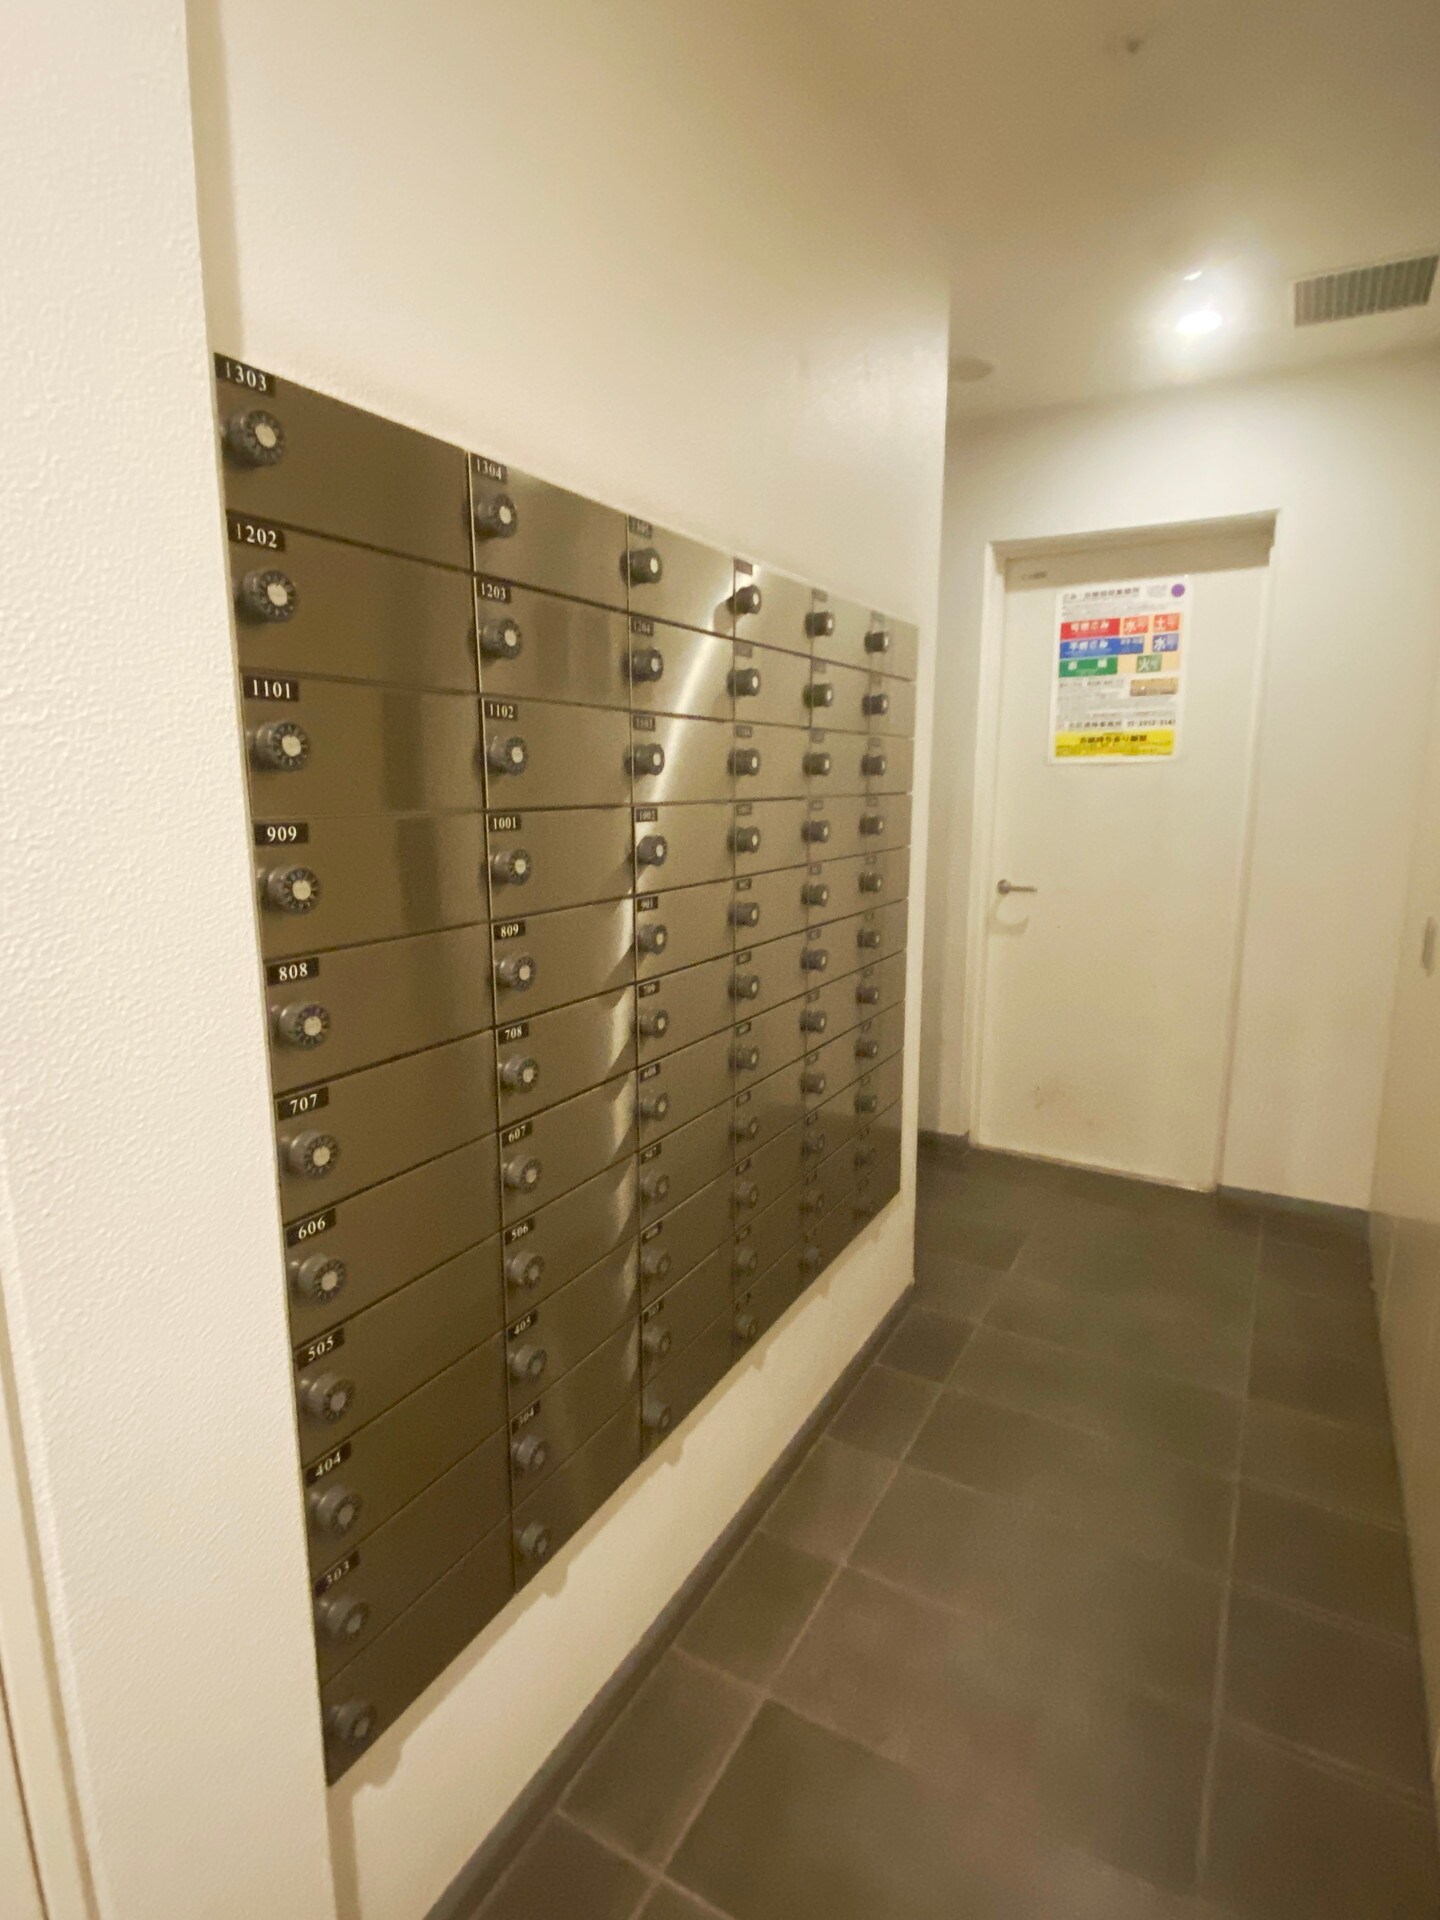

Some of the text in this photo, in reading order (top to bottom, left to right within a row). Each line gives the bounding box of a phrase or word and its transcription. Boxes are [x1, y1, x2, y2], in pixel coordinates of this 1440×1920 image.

[226, 362, 267, 392] 1303
[476, 458, 502, 480] 1304
[236, 523, 277, 548] 1202
[481, 582, 506, 600] 1203
[253, 679, 291, 699] 1101
[490, 703, 514, 718] 1102
[493, 816, 517, 830] 1001
[267, 826, 297, 843] 909
[500, 923, 519, 938] 809
[278, 963, 308, 981] 808
[504, 1026, 522, 1040] 708
[289, 1094, 318, 1115] 707
[508, 1125, 526, 1142] 607
[298, 1216, 326, 1239] 606
[511, 1225, 529, 1241] 506
[514, 1315, 531, 1335] 405
[308, 1335, 334, 1361] 505
[315, 1452, 341, 1476] 404
[326, 1560, 350, 1589] 303
